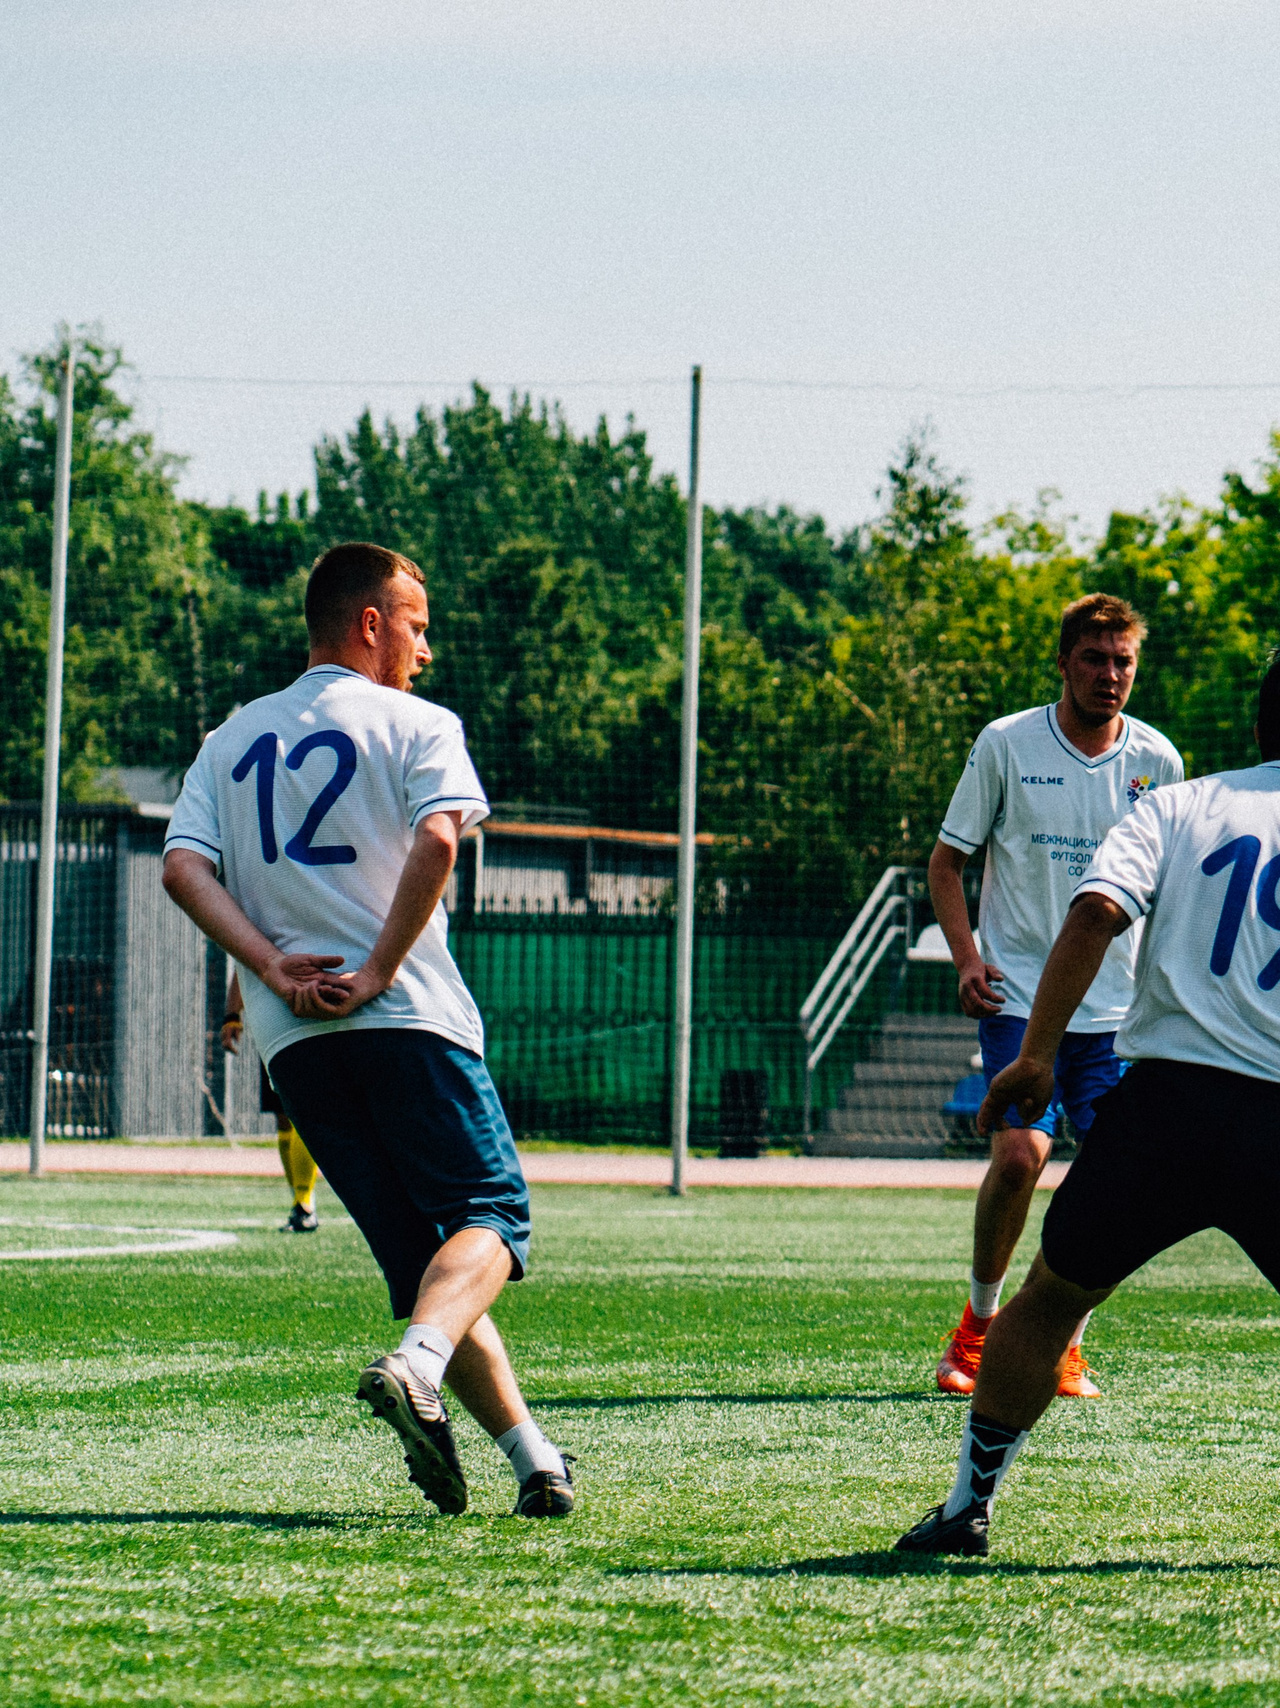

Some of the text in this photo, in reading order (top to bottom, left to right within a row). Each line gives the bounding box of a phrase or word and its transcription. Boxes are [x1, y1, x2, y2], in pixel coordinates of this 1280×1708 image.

[1021, 776, 1064, 785] KELME
[231, 729, 357, 866] 12
[1068, 866, 1085, 876] СО
